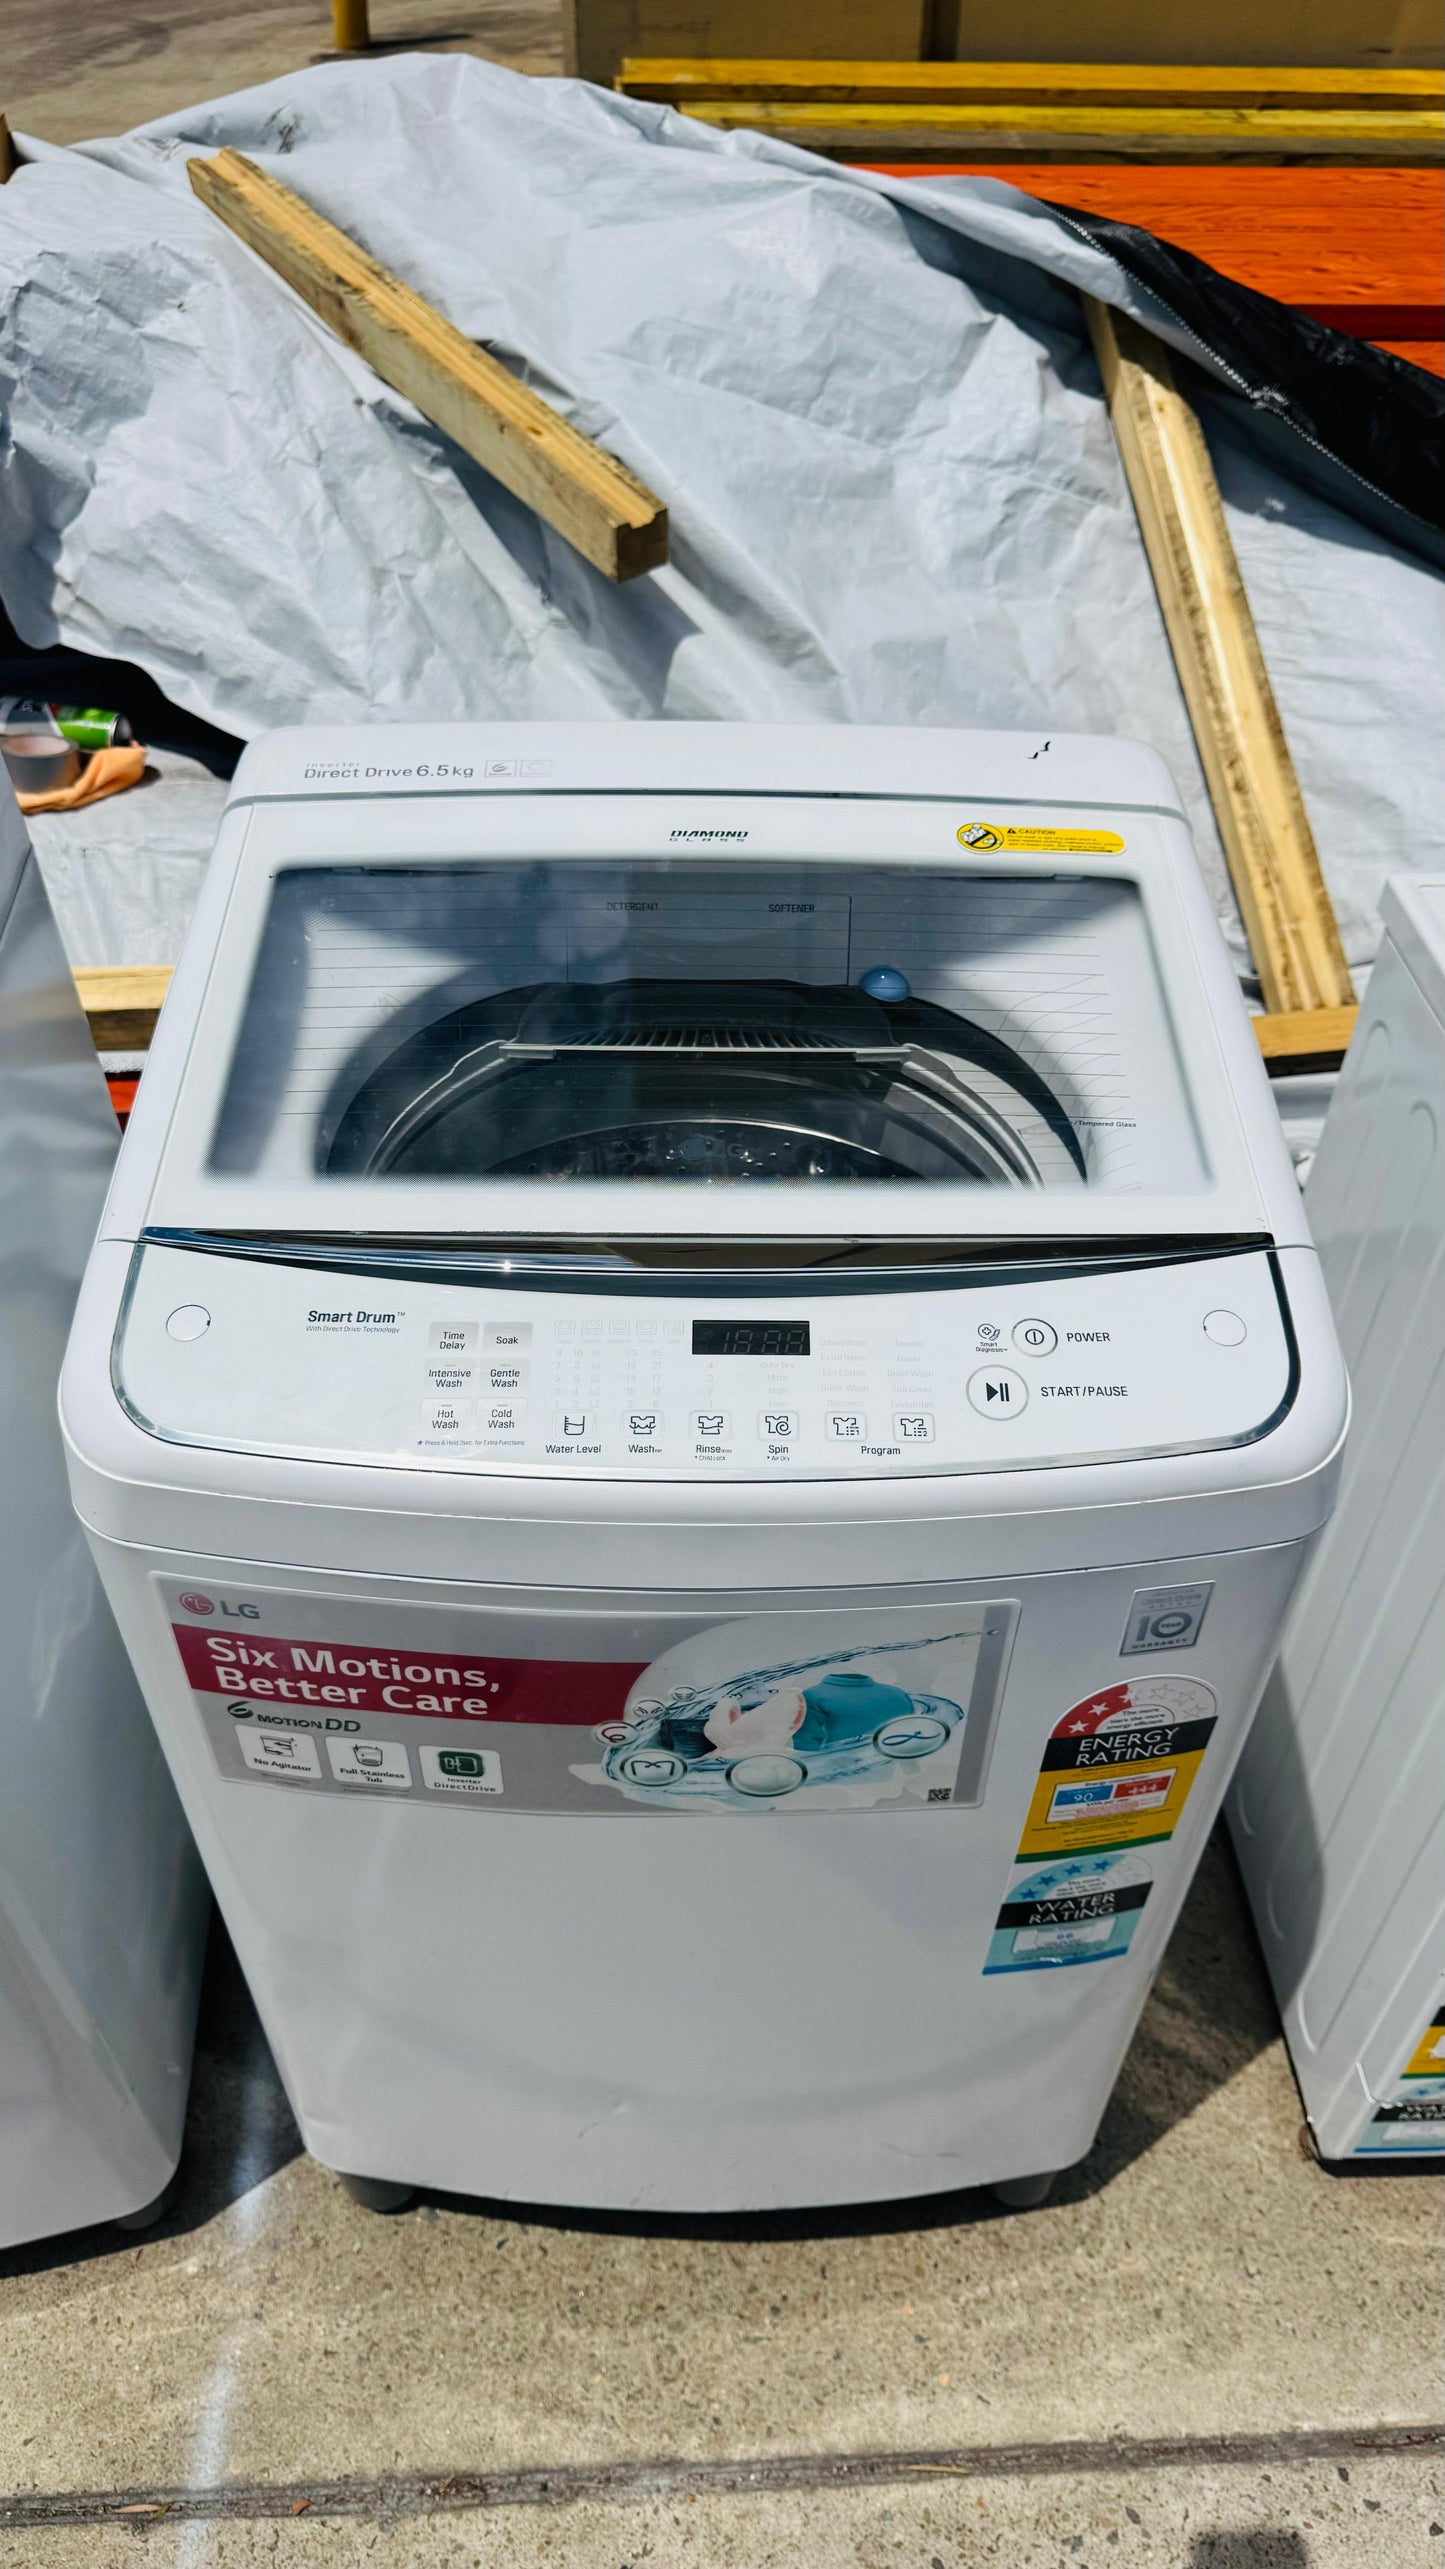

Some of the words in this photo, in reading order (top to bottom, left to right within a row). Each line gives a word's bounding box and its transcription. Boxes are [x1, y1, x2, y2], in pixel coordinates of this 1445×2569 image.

[304, 767, 360, 779] Direct
[365, 766, 412, 778] Drive
[670, 830, 749, 838] DIAMOND
[606, 901, 659, 911] DETERGENT
[767, 902, 816, 913] SOFTENER
[1115, 1120, 1137, 1128] Glass
[307, 1310, 353, 1323] Smart
[442, 1331, 465, 1340] Time
[495, 1336, 519, 1345] Soak
[1066, 1332, 1111, 1342] POWER
[439, 1341, 466, 1350] Delay
[428, 1368, 472, 1378] Intensive
[490, 1368, 521, 1378] Gentle
[435, 1379, 463, 1388] Wash
[491, 1379, 518, 1388] Wash
[1040, 1386, 1129, 1397] START/PAUSE
[437, 1409, 454, 1418] Hot
[491, 1409, 513, 1418] Cold
[431, 1419, 459, 1429] Wash
[488, 1419, 515, 1429] Wash
[545, 1444, 574, 1453] Water
[576, 1444, 601, 1453] Level
[768, 1444, 789, 1455] Spin
[861, 1445, 901, 1456] Program
[221, 1600, 261, 1619] LG
[206, 1636, 280, 1669] Six
[290, 1646, 501, 1694] Motions,
[215, 1665, 367, 1705] Better
[381, 1683, 488, 1716] Care
[1079, 1726, 1180, 1751] ENERGY
[1075, 1742, 1173, 1766] RATING
[253, 1757, 269, 1765] No
[271, 1760, 312, 1771] Agitator
[340, 1767, 358, 1775] Full
[361, 1768, 405, 1779] Stainless
[1036, 1892, 1116, 1913] WATER
[1029, 1905, 1115, 1925] RATING
